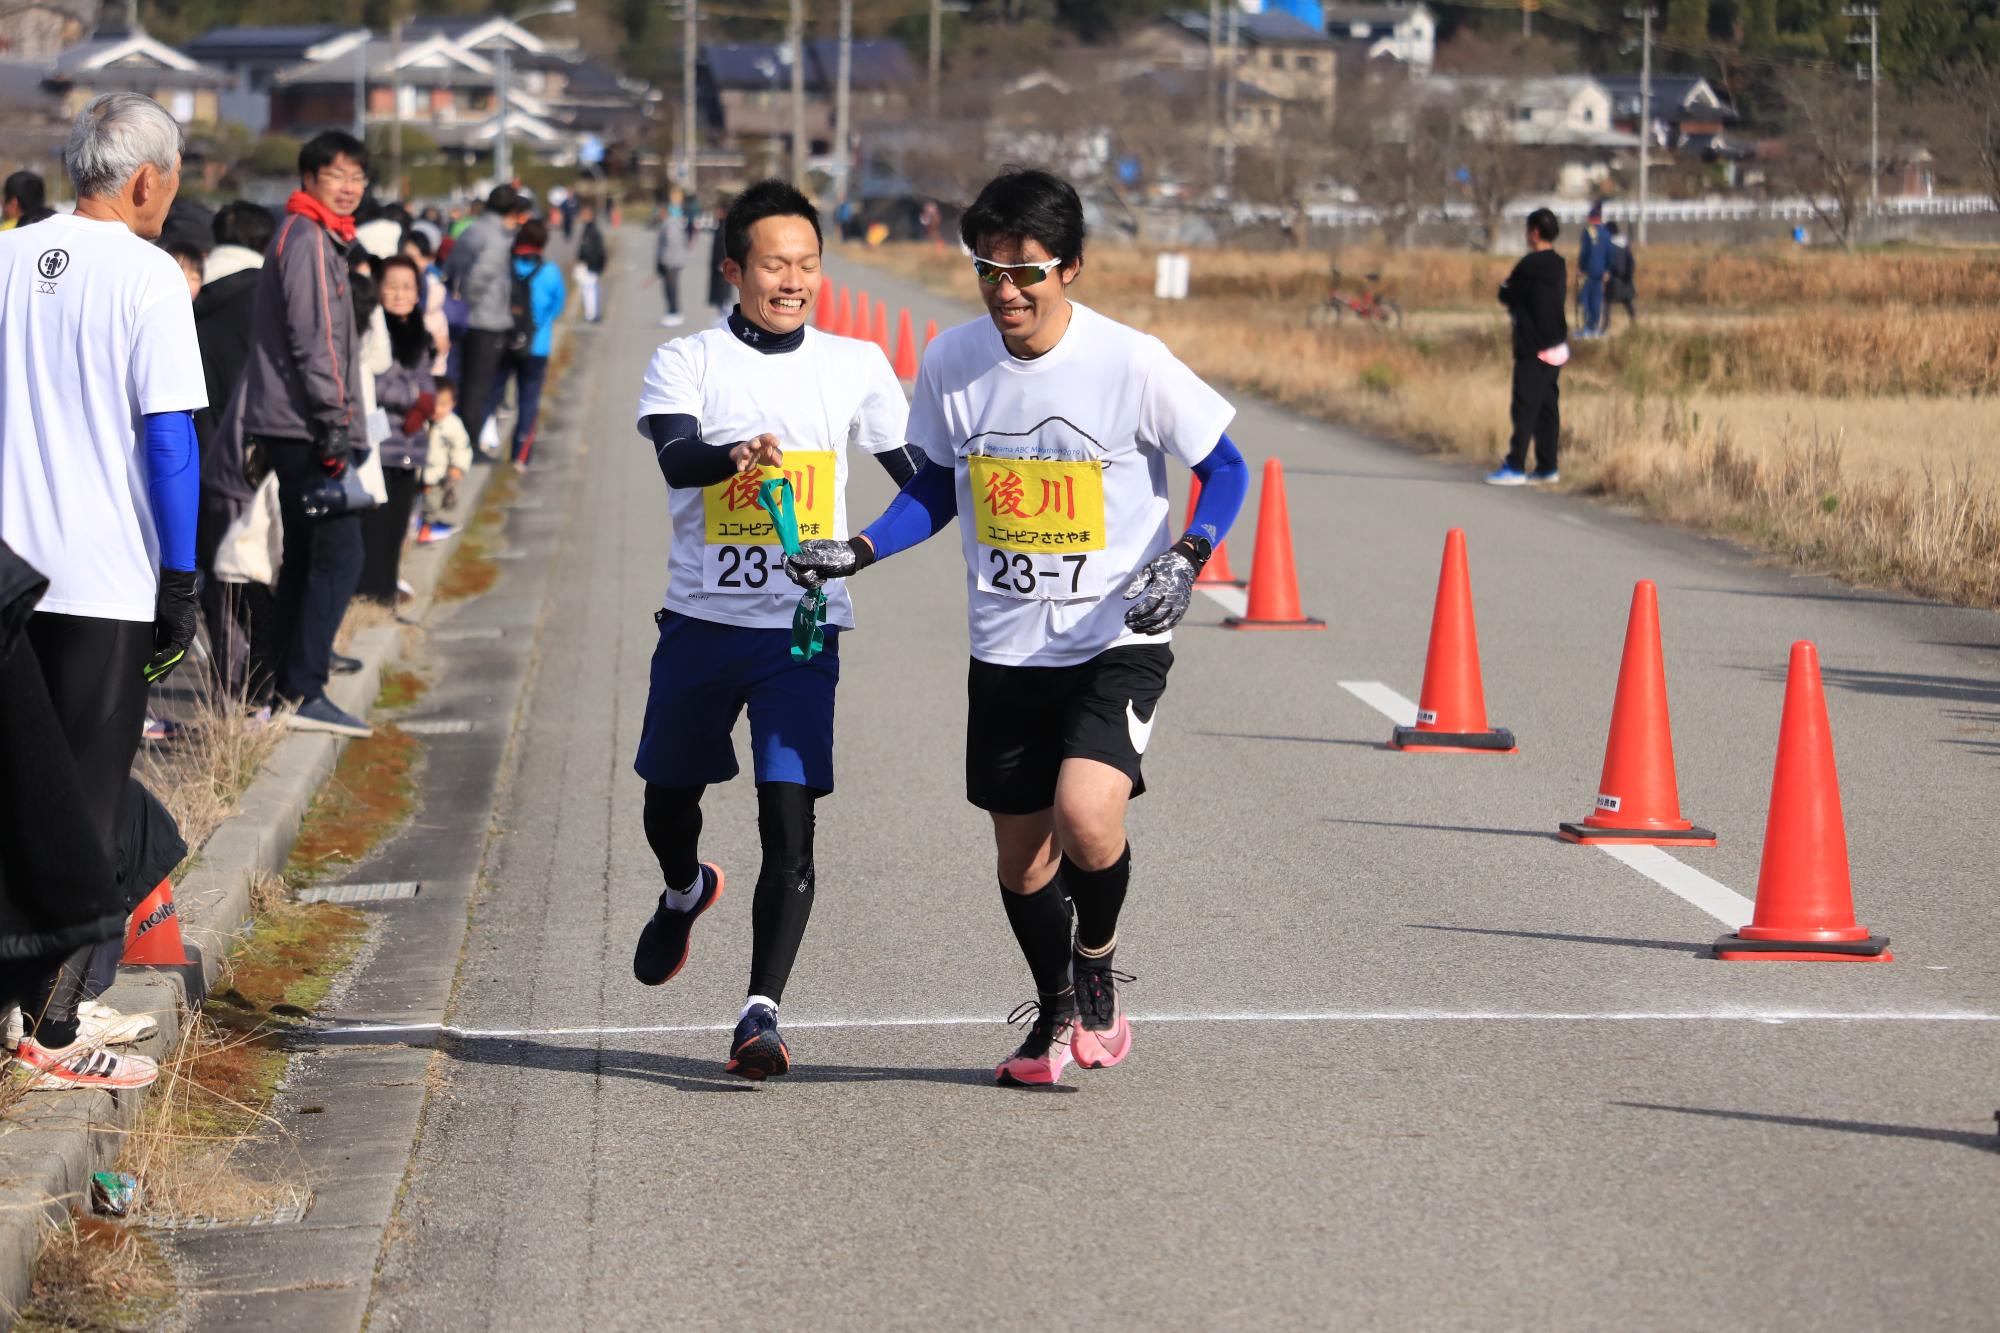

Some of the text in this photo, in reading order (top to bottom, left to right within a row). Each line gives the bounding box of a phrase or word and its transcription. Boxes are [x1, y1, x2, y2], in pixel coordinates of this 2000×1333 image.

[1014, 446, 1030, 454] ABC
[984, 471, 1076, 521] 後川
[718, 522, 821, 536] ユニトピアやま
[988, 526, 1091, 544] ユニトピアささやま
[990, 548, 1087, 594] 23-7
